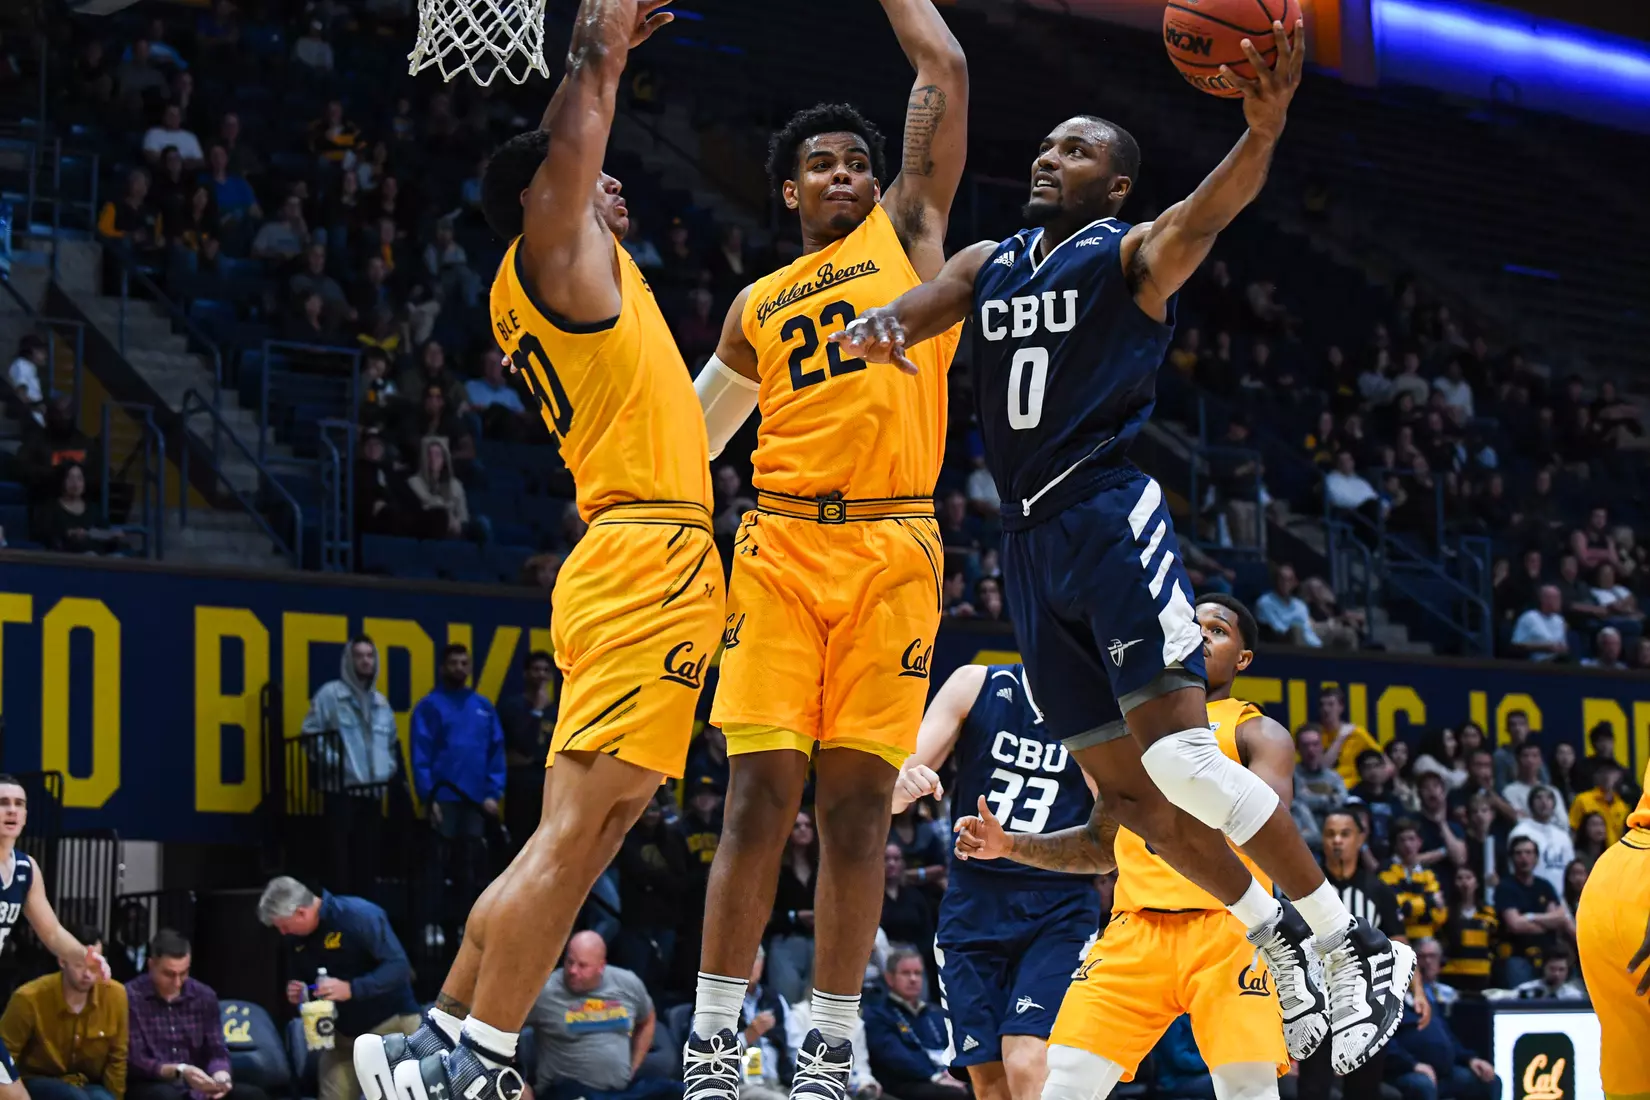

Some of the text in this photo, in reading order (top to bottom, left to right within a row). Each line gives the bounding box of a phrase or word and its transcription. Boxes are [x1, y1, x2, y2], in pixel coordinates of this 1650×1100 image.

[1076, 237, 1103, 248] WAC
[757, 260, 880, 328] Golden Bears
[981, 290, 1079, 341] CBU
[780, 300, 867, 391] 22
[1007, 346, 1049, 430] 0
[660, 641, 707, 689] Cal
[898, 638, 932, 679] Cal
[991, 731, 1069, 773] CBU
[978, 767, 1060, 834] 33
[1238, 964, 1271, 997] Cal
[1522, 1053, 1566, 1100] Cal
